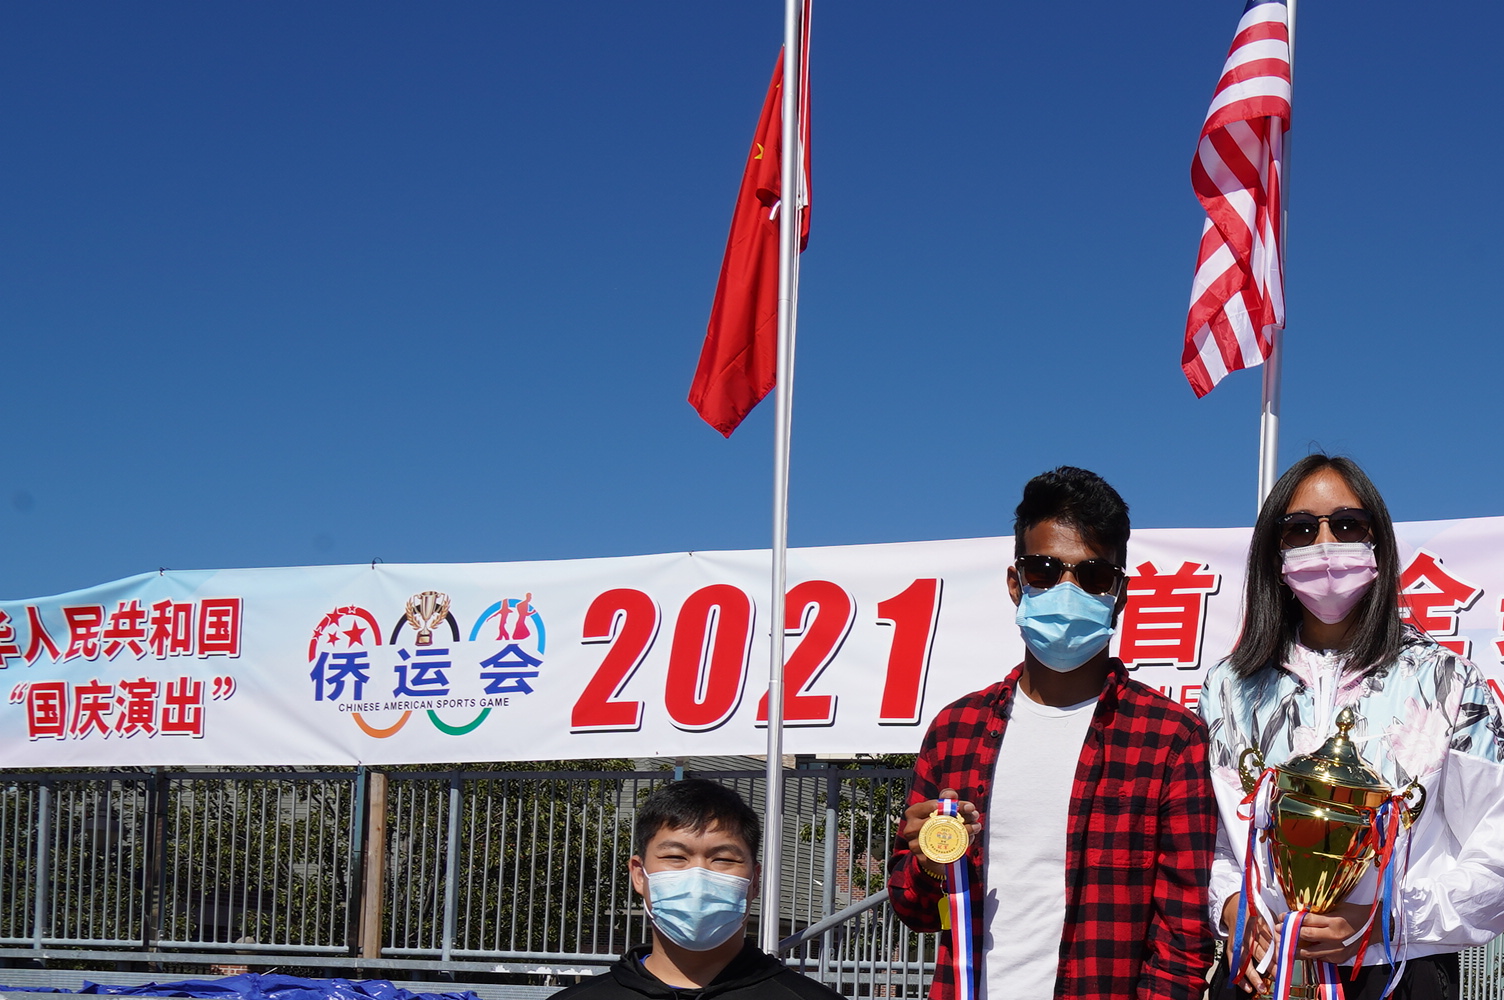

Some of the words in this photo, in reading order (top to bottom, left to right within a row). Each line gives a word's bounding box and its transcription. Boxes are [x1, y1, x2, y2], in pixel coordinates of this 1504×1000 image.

[310, 643, 543, 702] 侨运会
[570, 578, 943, 733] 2021
[338, 702, 380, 713] CHINESE
[383, 700, 433, 711] AMERICAN
[436, 699, 476, 709] SPORTS
[480, 697, 510, 707] GAME
